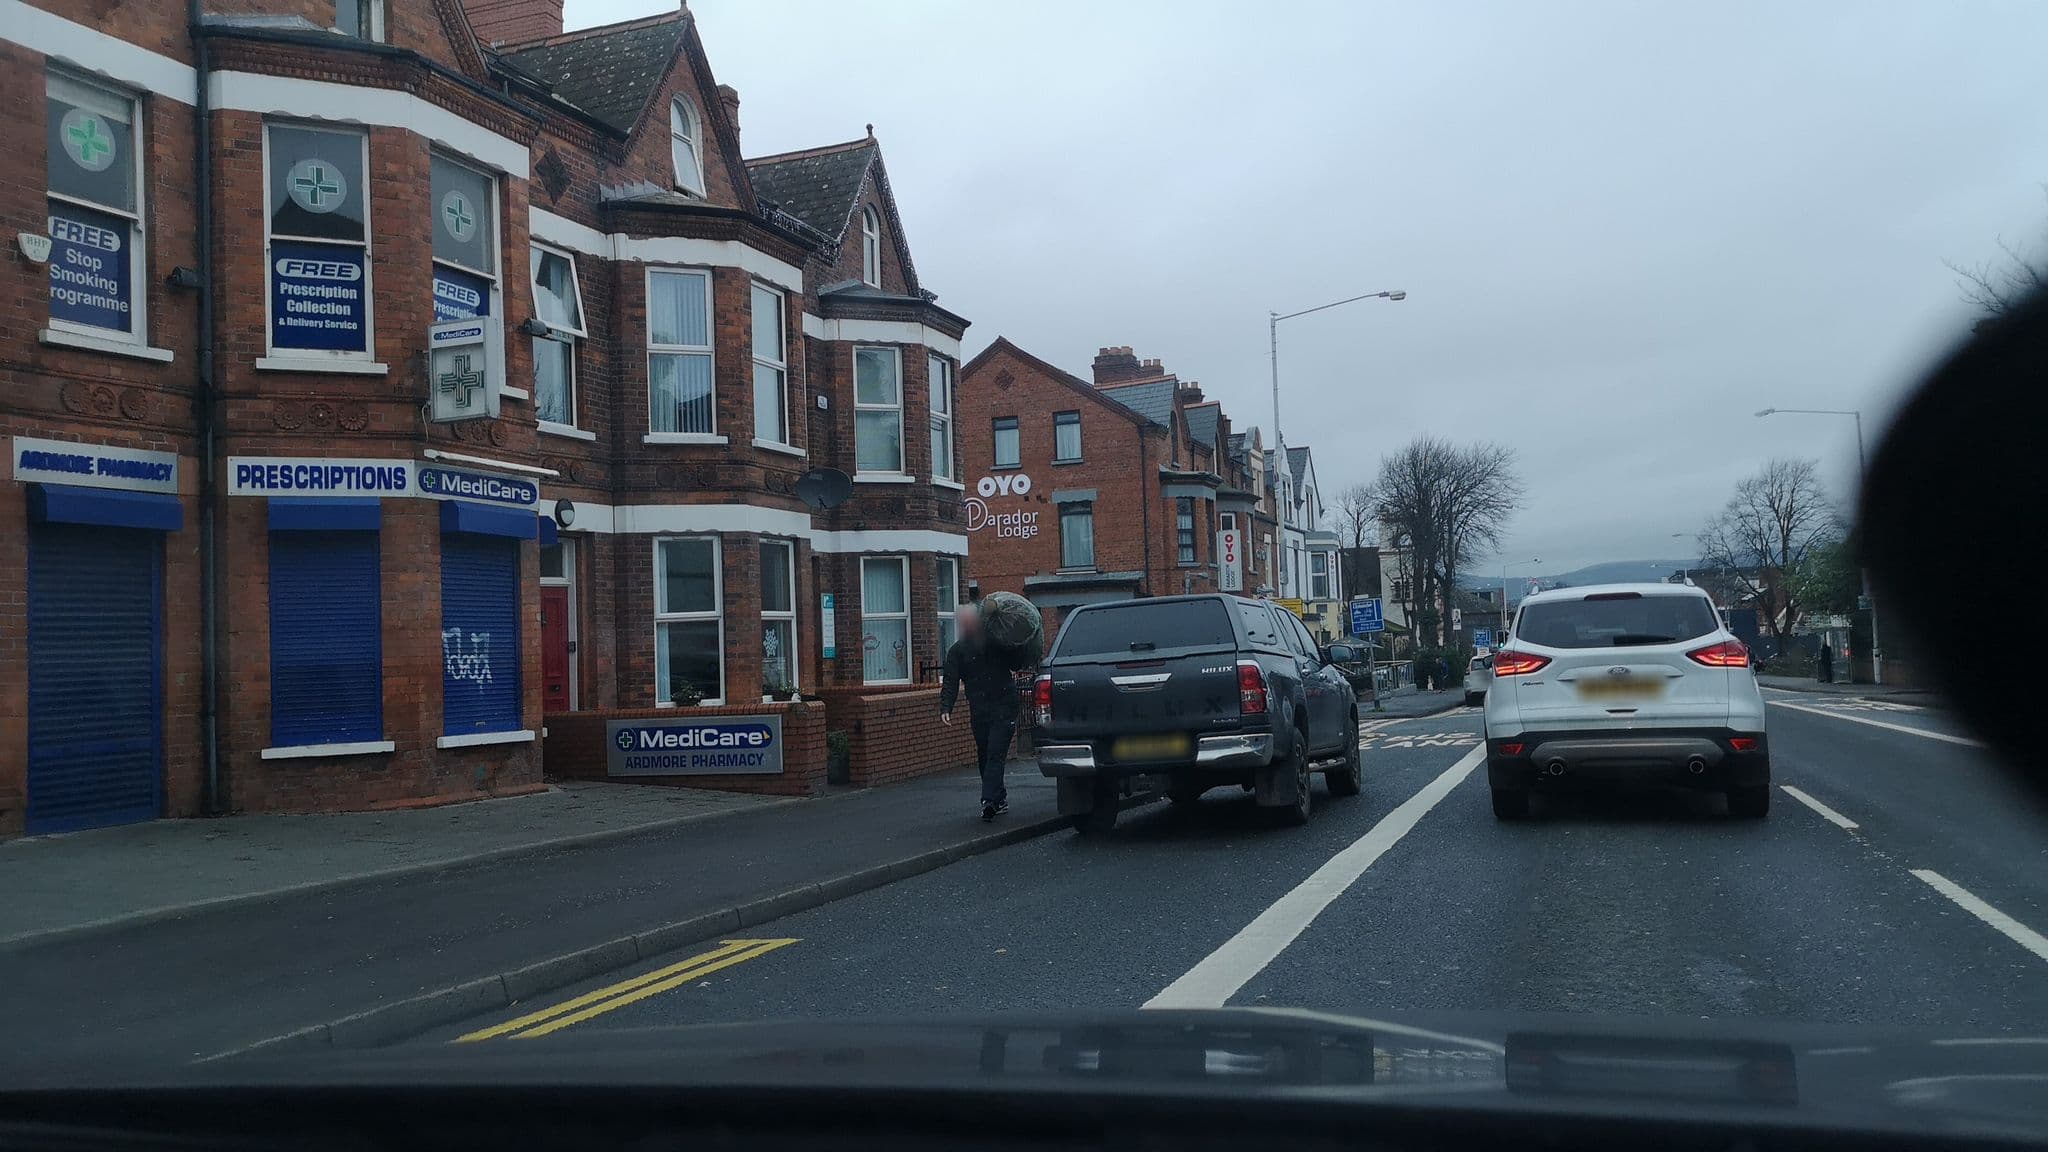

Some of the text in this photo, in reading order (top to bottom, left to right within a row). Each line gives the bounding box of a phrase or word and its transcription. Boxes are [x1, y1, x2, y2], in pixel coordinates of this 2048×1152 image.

[52, 219, 115, 250] FREE
[66, 248, 102, 272] Stop
[284, 261, 354, 278] FREE
[49, 264, 118, 295] Smoking
[280, 282, 357, 299] Prescription
[49, 286, 129, 312] rogramme
[437, 282, 476, 304] FREE
[286, 299, 351, 316] Collection
[278, 317, 358, 330] & Delivery Service
[440, 329, 480, 339] MediCare
[19, 450, 173, 481] ARDMORE PHARMACY
[237, 464, 407, 490] PRESCRIPTIONS
[441, 474, 531, 502] MediCare
[977, 473, 1031, 498] OYO
[965, 497, 1039, 531] Parador
[997, 522, 1038, 539] Lodge
[1225, 534, 1234, 562] OYO
[1201, 665, 1233, 674] HILUX
[640, 728, 763, 749] MediCare
[625, 753, 764, 769] ARDMORE PHARMACY
